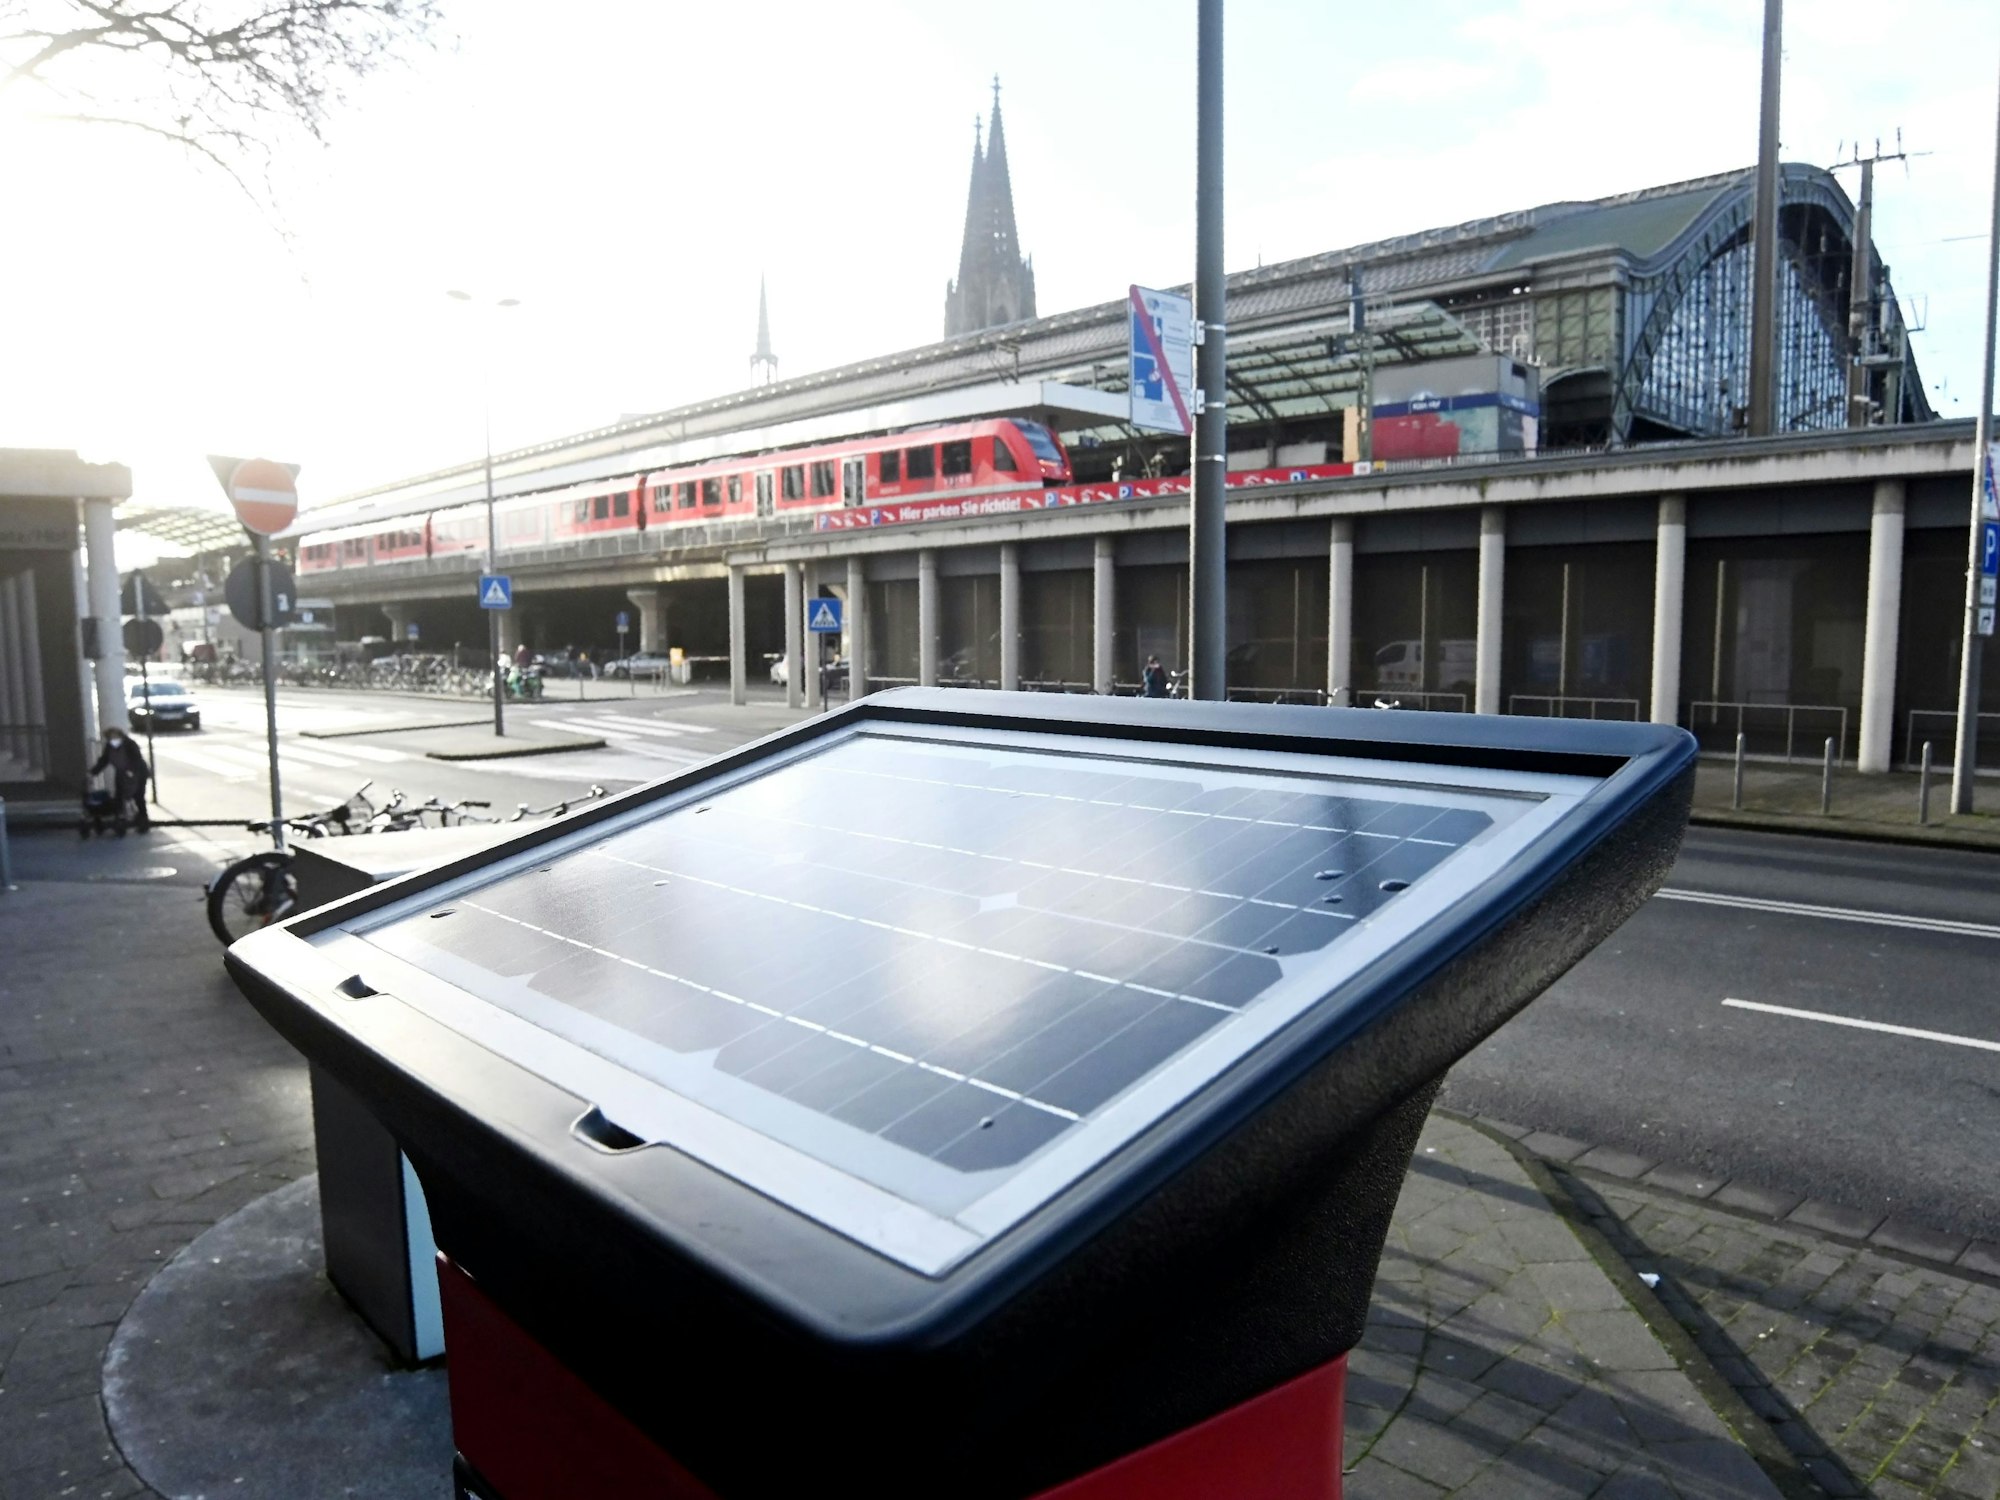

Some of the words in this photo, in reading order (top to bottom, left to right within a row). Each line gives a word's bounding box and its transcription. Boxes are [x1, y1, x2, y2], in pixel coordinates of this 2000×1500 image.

[899, 506, 922, 521] Hier
[922, 503, 960, 522] parken
[961, 499, 978, 516] Sie
[1985, 528, 1996, 568] P
